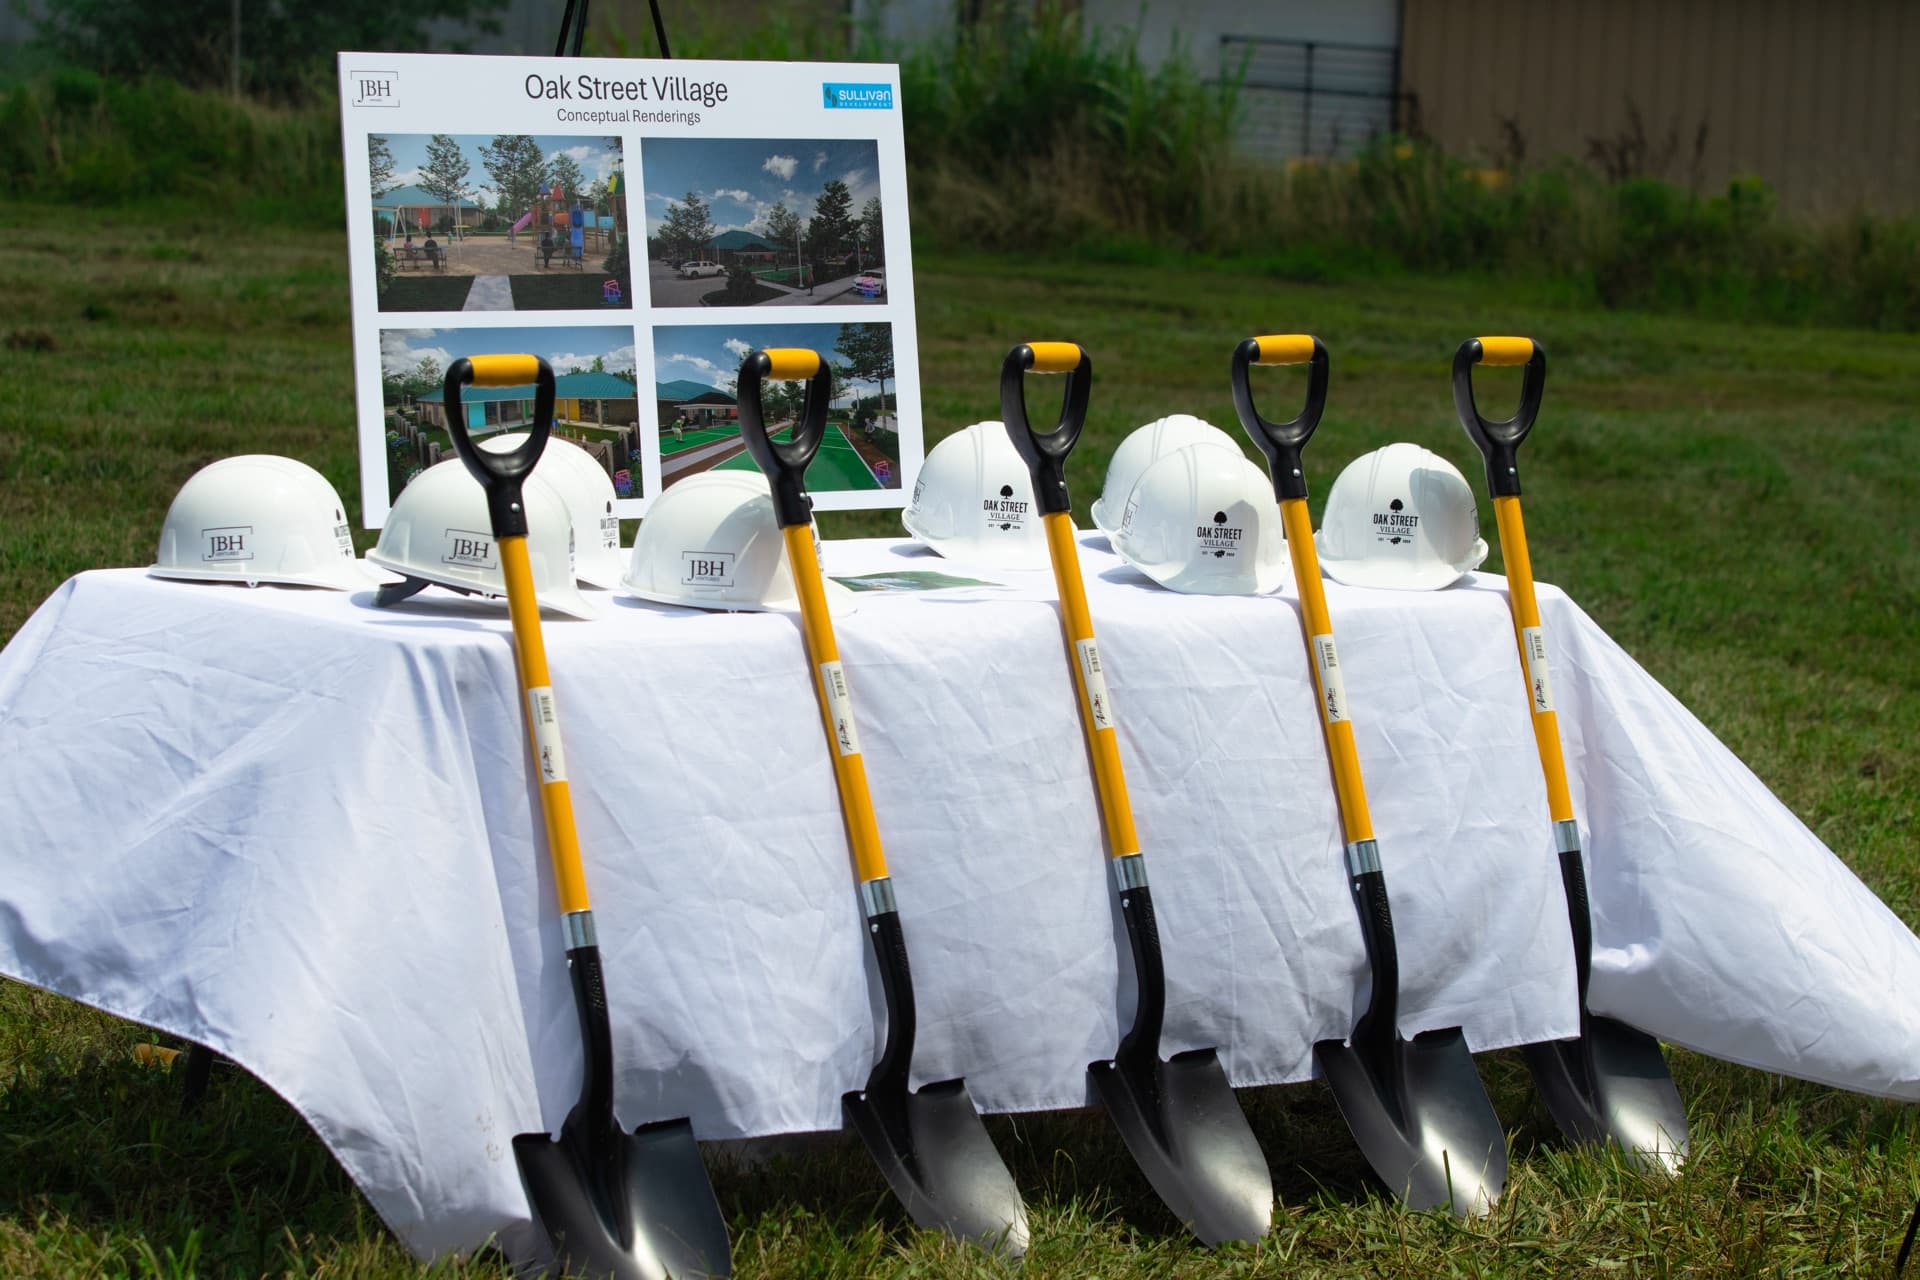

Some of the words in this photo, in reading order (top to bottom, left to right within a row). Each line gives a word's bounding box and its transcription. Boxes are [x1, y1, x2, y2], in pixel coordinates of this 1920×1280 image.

[357, 80, 391, 103] JBH
[525, 74, 572, 100] Oak
[577, 75, 648, 101] Street
[652, 76, 728, 108] Village
[557, 109, 629, 124] Conceptual
[633, 109, 701, 126] Renderings
[983, 500, 998, 511] OAK
[1000, 501, 1028, 513] STREET
[990, 512, 1020, 520] VILLAGE
[1373, 513, 1388, 525] OAK
[1390, 514, 1419, 527] STREET
[1197, 526, 1212, 538] OAK
[1214, 528, 1242, 540] STREET
[1380, 526, 1411, 535] VILLAGE
[207, 535, 243, 558] JBH
[448, 538, 489, 560] JBH
[1204, 539, 1235, 547] VILLAGE
[687, 560, 725, 581] JBH
